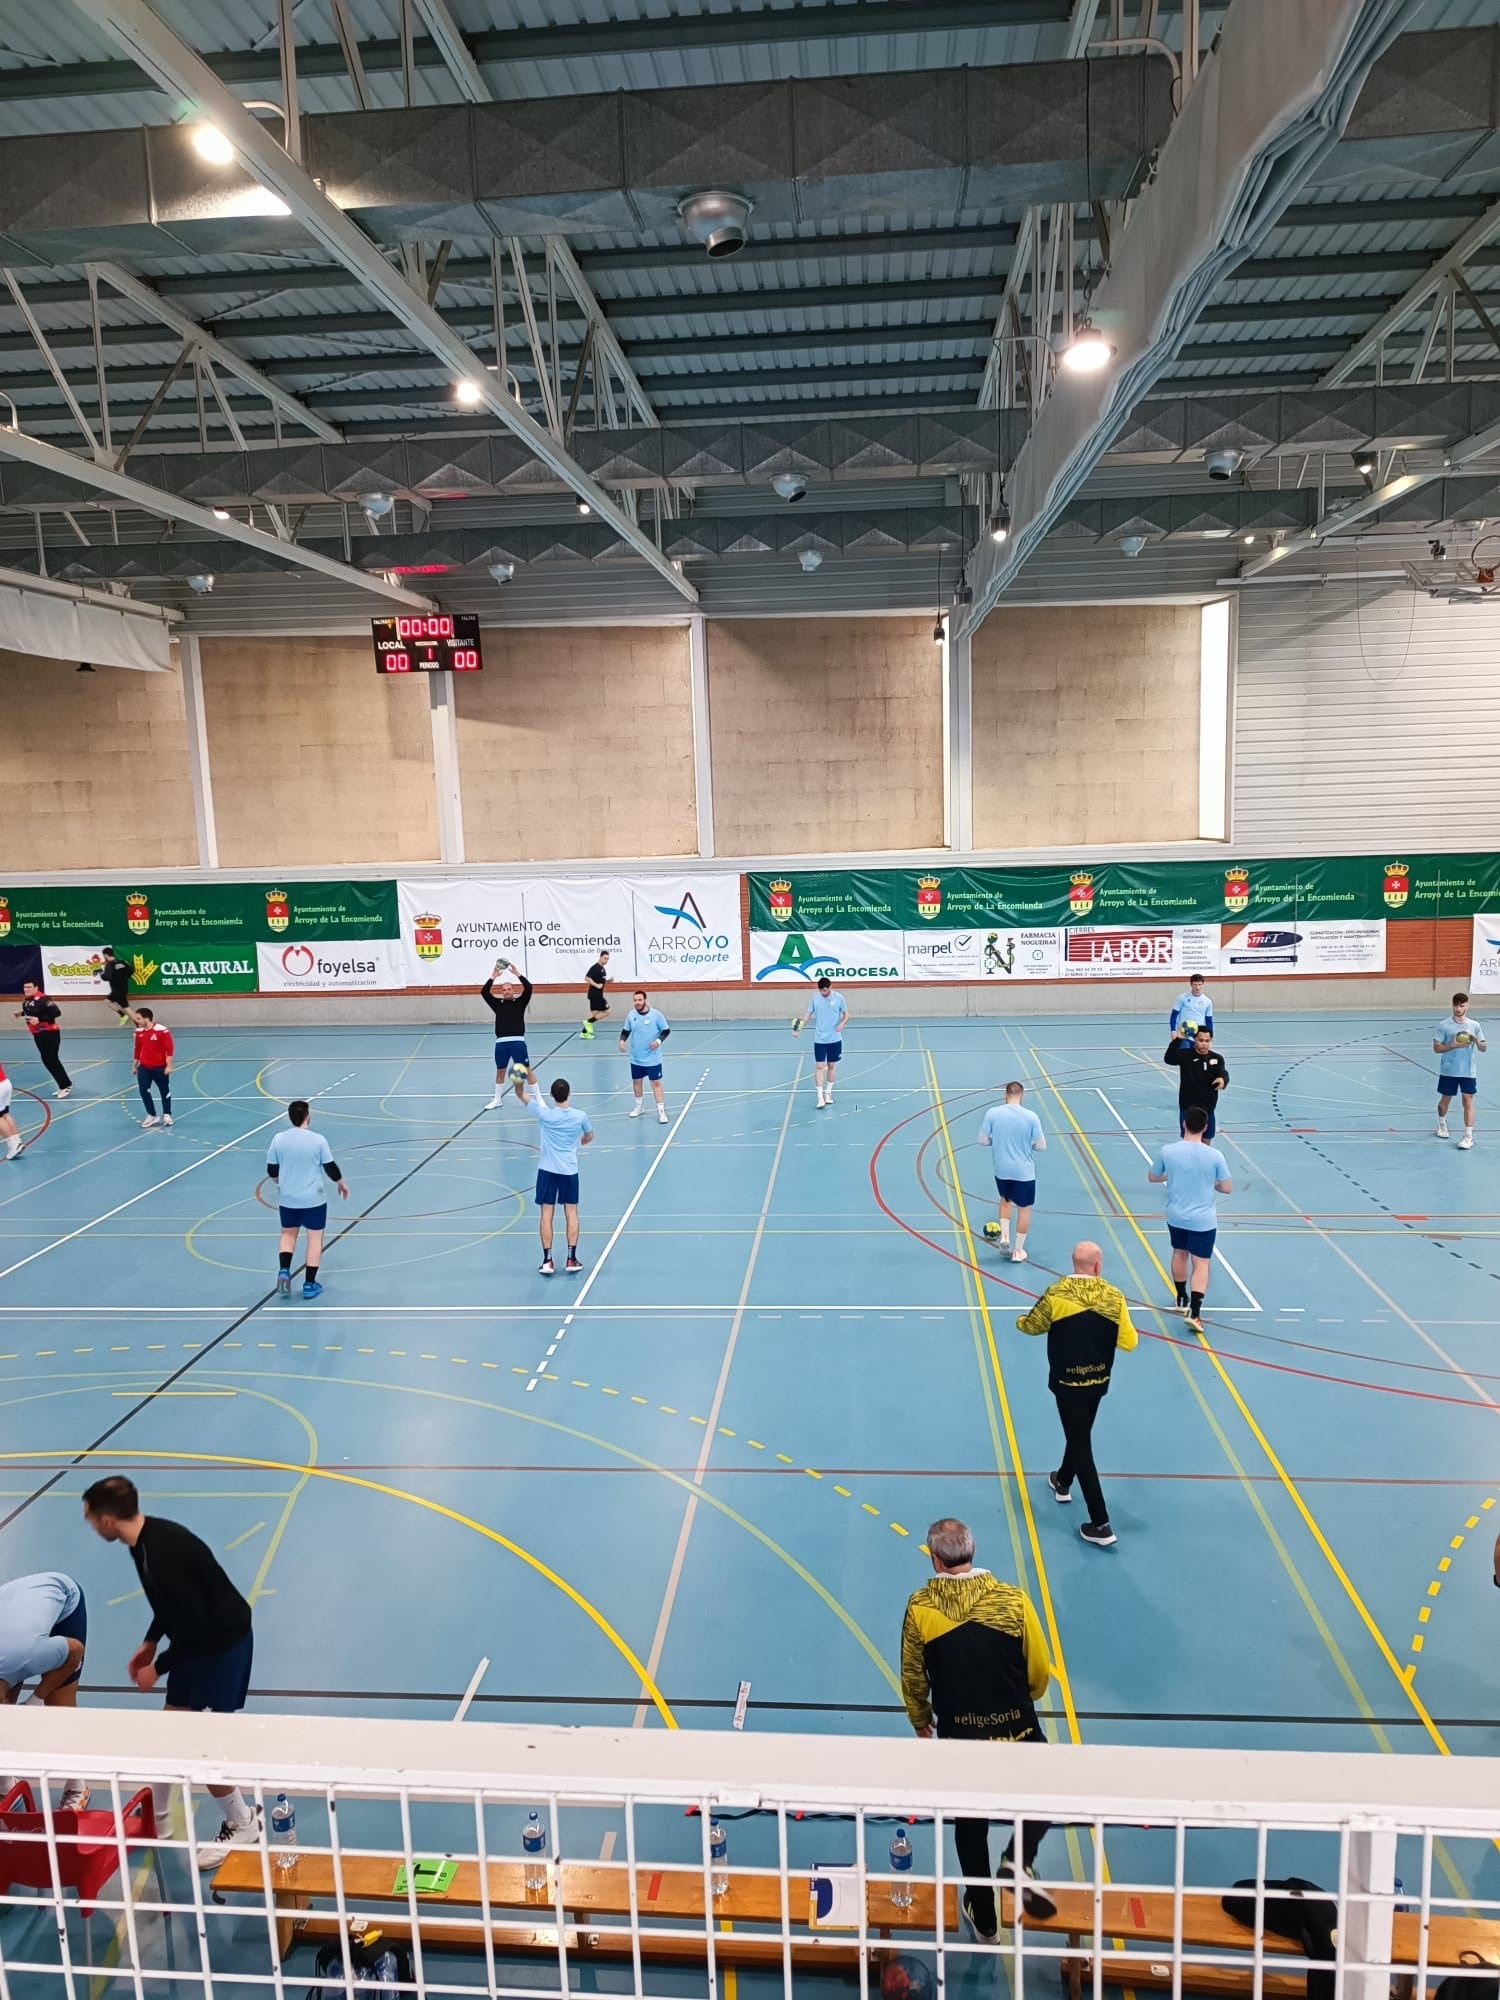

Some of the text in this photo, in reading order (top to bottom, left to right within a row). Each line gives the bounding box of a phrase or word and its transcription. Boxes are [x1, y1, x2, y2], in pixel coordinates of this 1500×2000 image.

[400, 618, 450, 636] 00:00
[378, 642, 406, 650] LOCAL
[386, 654, 408, 670] 00
[454, 652, 476, 668] 00
[1255, 885, 1302, 893] Ayuntamiento
[1415, 880, 1464, 890] Ayuntamiento
[947, 892, 992, 901] Ayuntamiento
[1415, 891, 1440, 900] Arroyo
[1470, 889, 1500, 897] Encomi
[1100, 899, 1124, 908] Arroyo
[1255, 896, 1280, 904] Arroyo
[154, 908, 196, 916] Ayuntamiento
[294, 906, 336, 915] Ayuntamiento
[799, 906, 822, 915] Arroyo
[947, 903, 972, 912] Arroyo
[15, 911, 57, 919] Ayuntamiento
[155, 919, 177, 928] Arroyo
[202, 917, 243, 925] Encomienda
[294, 916, 317, 925] Arroyo
[16, 922, 39, 930] Arroyo
[456, 921, 560, 933] AYUNTAMIENTO de
[1069, 927, 1096, 935] CIERRES
[452, 934, 620, 950] arroyo de la encomienda
[648, 936, 729, 950] ARROYO
[908, 942, 952, 957] marpel
[649, 953, 730, 964] 100% deporte
[160, 960, 253, 976] CAJA RURAL
[317, 958, 376, 977] foyelsa
[814, 967, 899, 977] AGROCESA
[954, 1708, 1020, 1728] #eligeSoria
